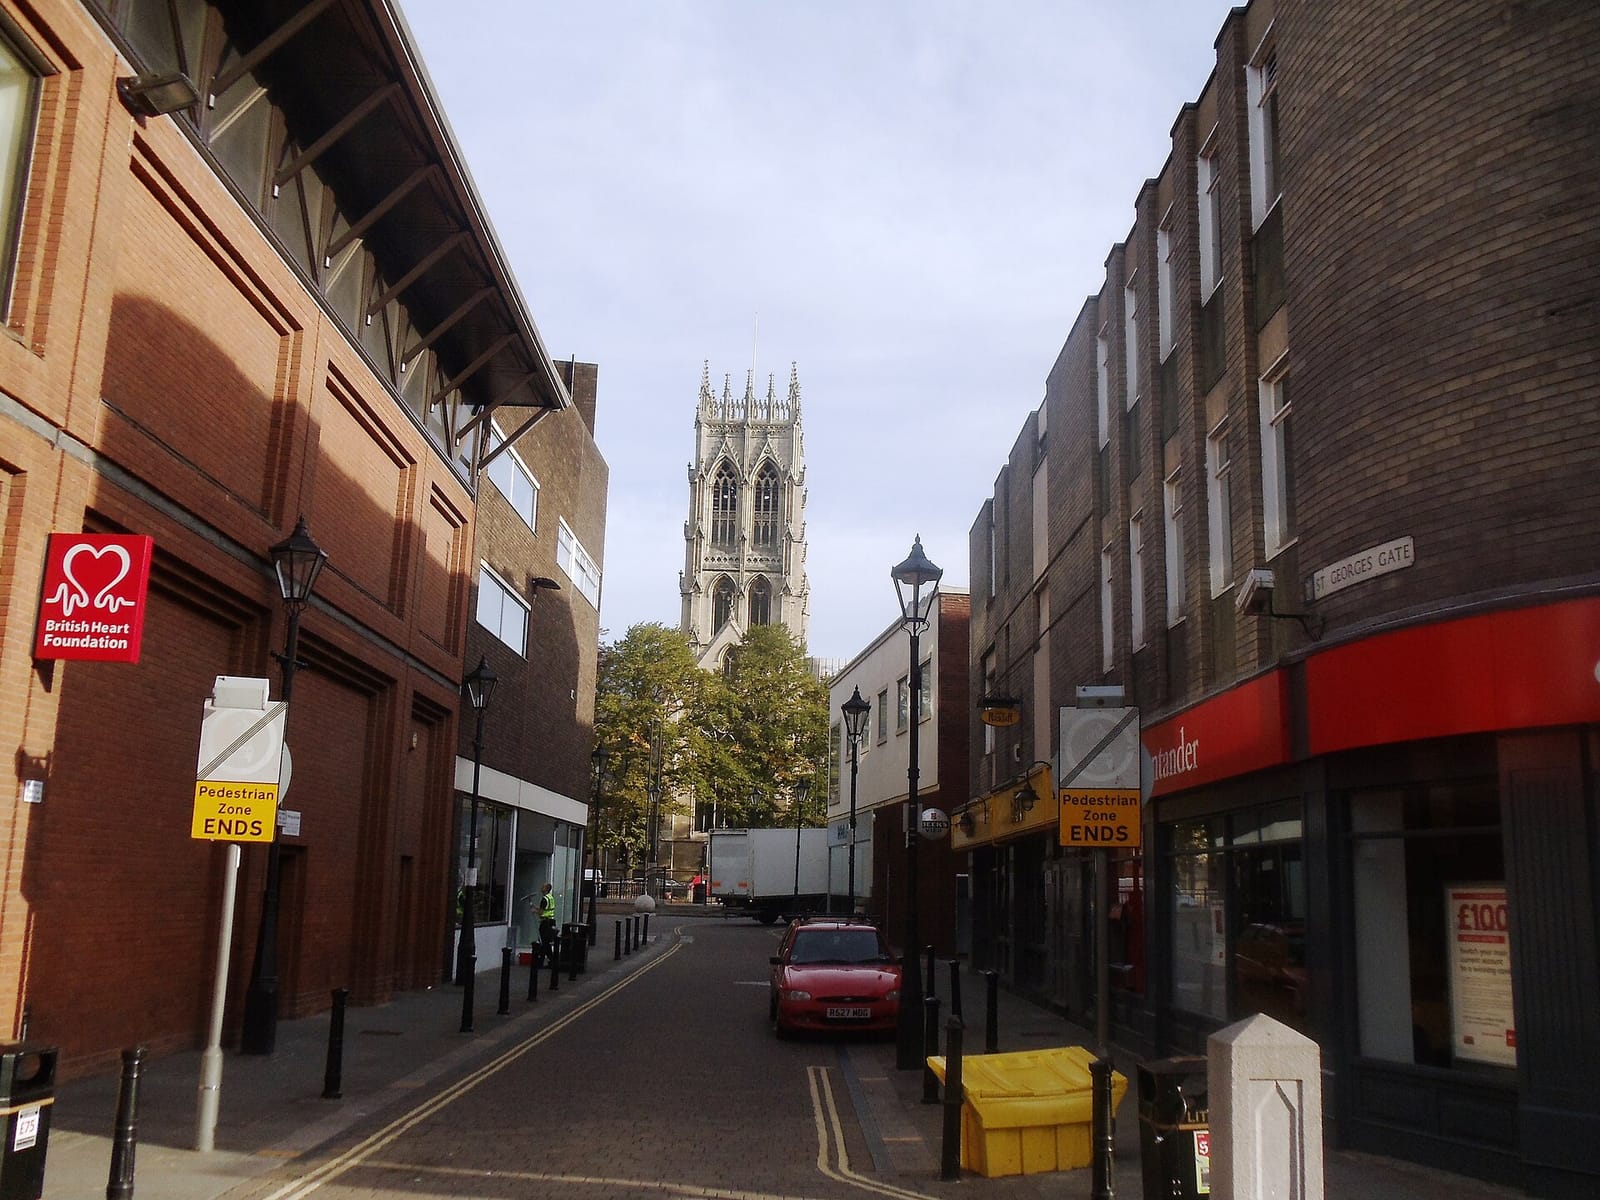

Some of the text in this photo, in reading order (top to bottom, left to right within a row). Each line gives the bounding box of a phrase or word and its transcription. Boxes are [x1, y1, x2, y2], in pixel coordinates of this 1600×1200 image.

[1316, 544, 1410, 592] ST GEORGES GATE
[45, 619, 129, 634] British Heart
[43, 633, 128, 649] Foundation
[199, 785, 274, 800] Pedestrian
[1063, 794, 1137, 806] Pedestrian
[218, 803, 252, 815] Zone
[1083, 810, 1117, 821] Zone
[204, 818, 262, 836] ENDS
[1071, 825, 1129, 841] ENDS
